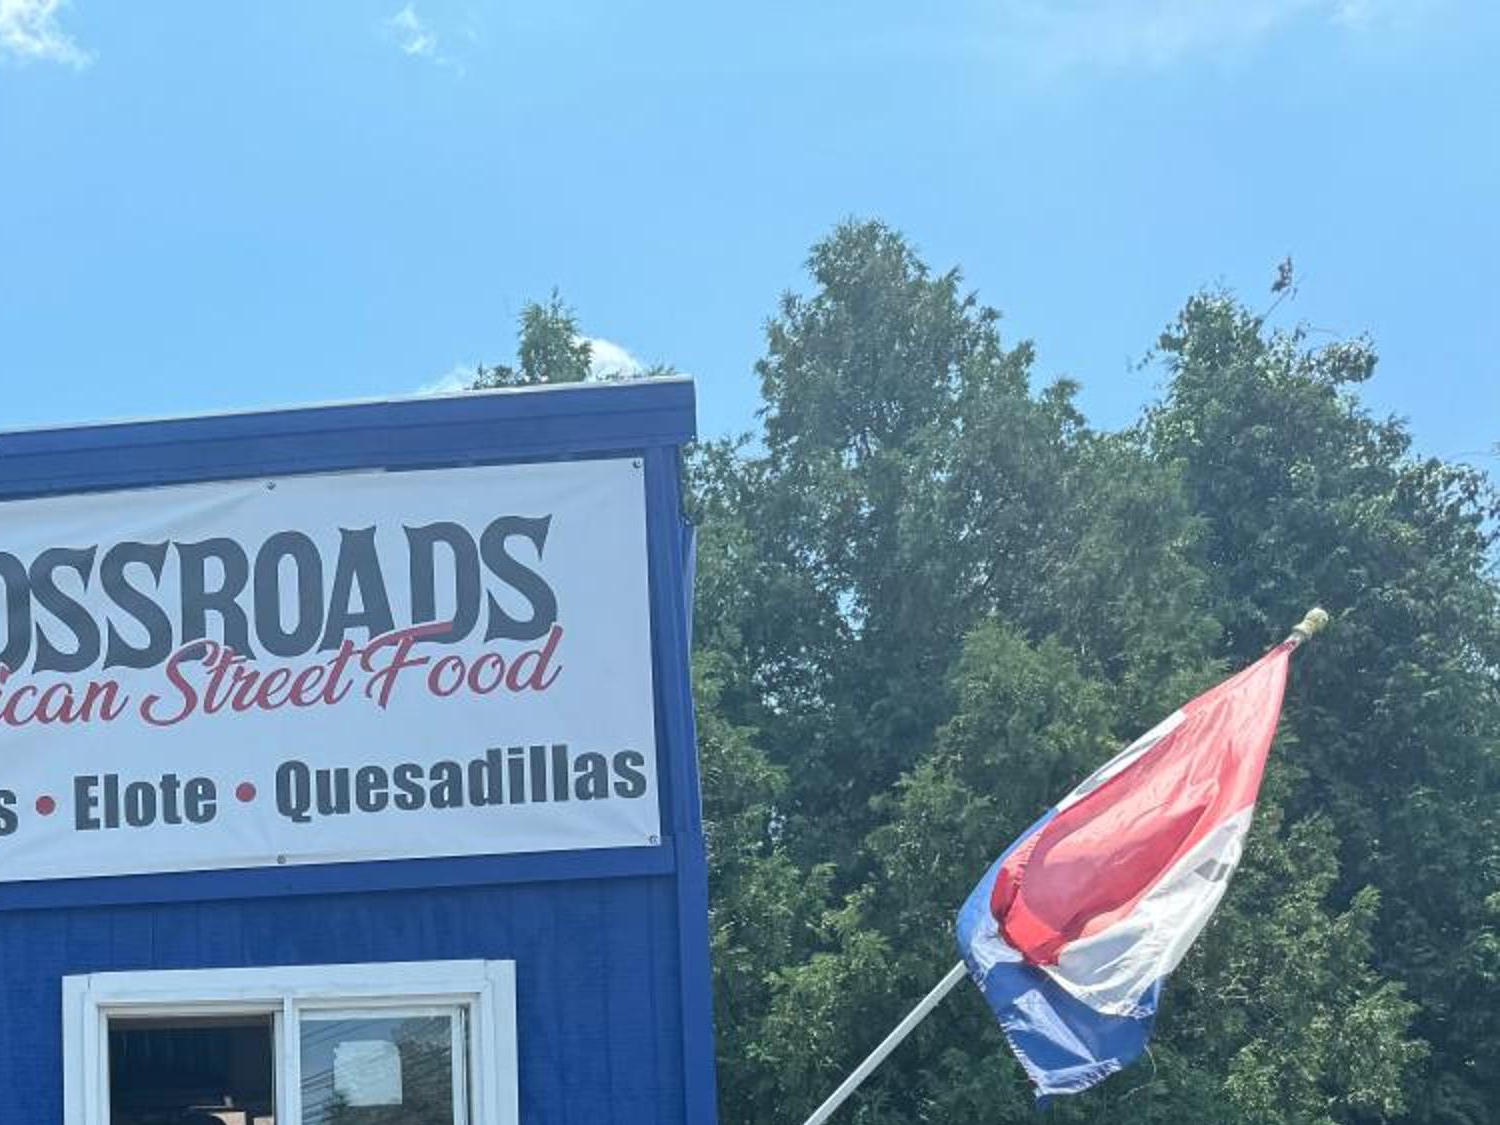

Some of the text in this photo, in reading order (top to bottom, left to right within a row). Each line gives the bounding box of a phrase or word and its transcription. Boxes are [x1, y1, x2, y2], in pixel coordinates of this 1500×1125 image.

[139, 638, 354, 726] Street
[360, 619, 564, 711] Food
[74, 771, 217, 831] Elote
[275, 744, 647, 823] Quesadillas
